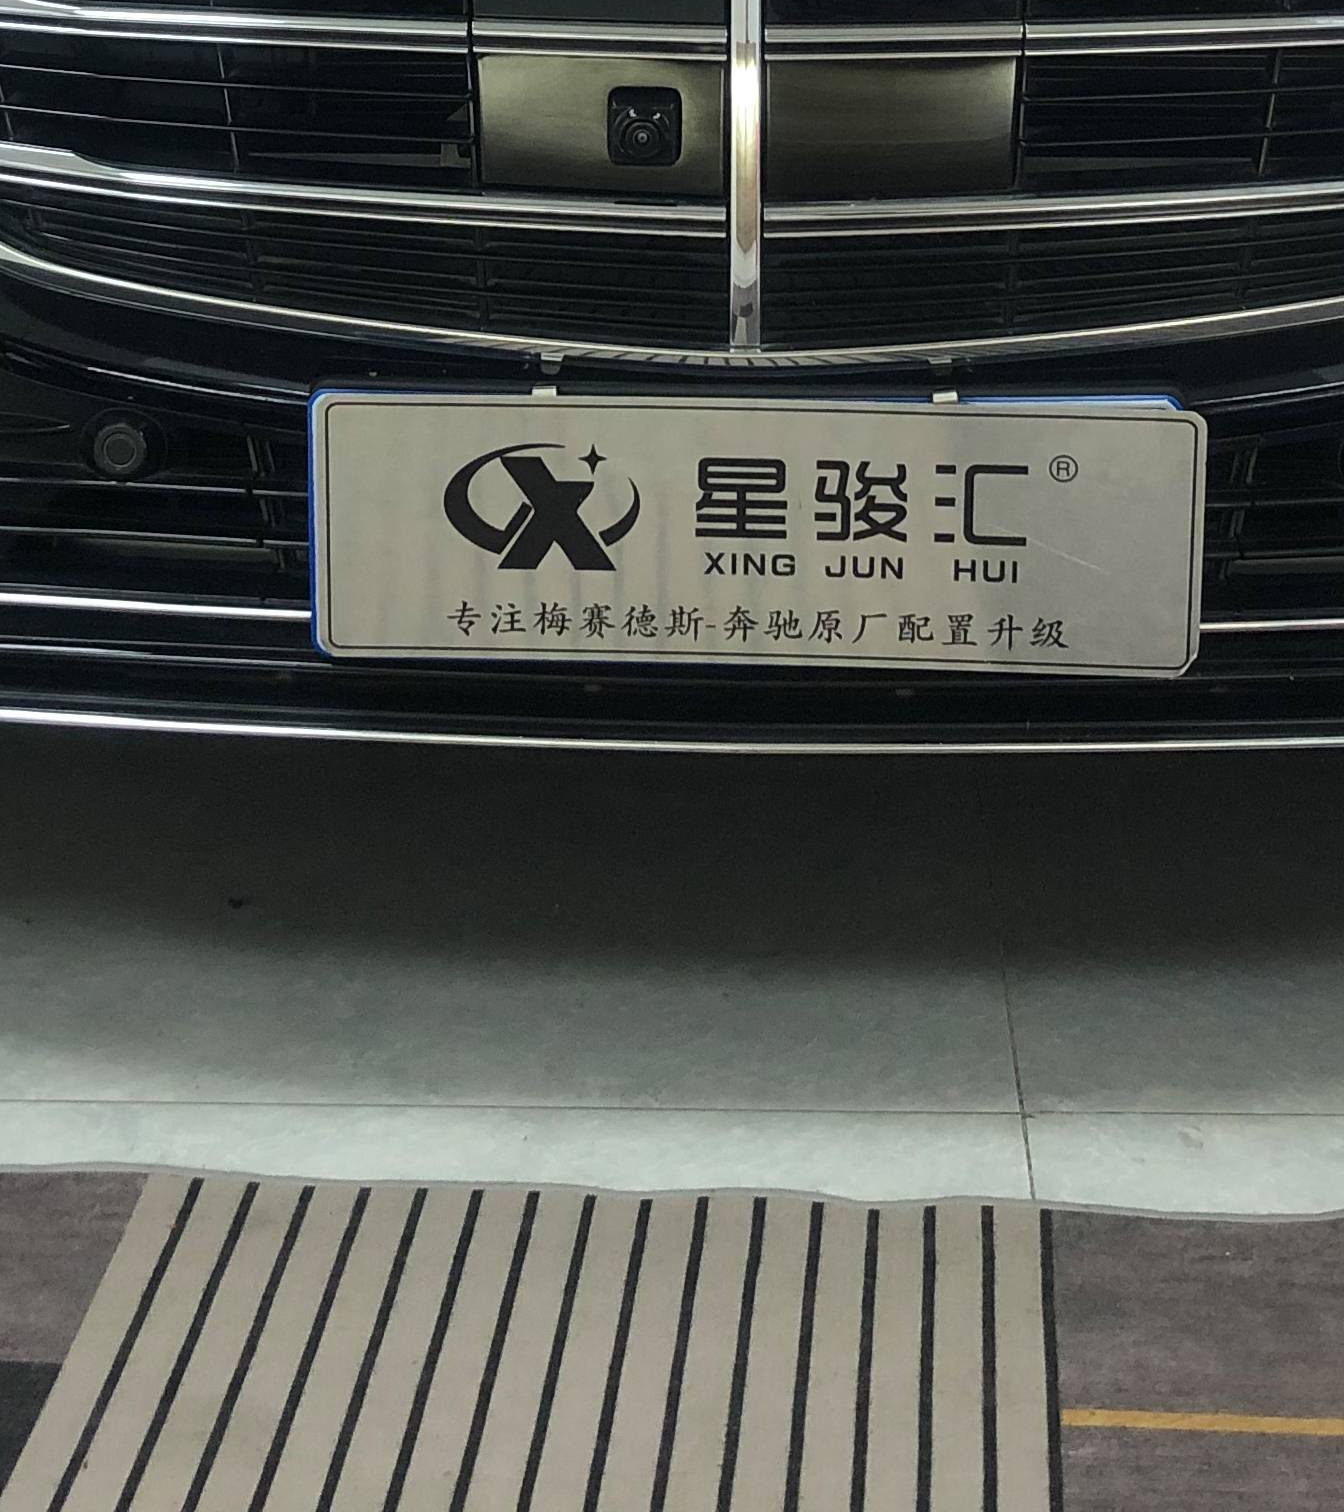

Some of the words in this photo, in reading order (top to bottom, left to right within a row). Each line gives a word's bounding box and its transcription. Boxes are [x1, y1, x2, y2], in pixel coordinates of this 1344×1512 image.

[693, 456, 1030, 548] 星骏汇
[703, 551, 796, 578] XING
[824, 553, 905, 580] JUN
[952, 557, 1021, 584] HUI
[447, 601, 1071, 652] 专注梅赛德斯-奔驰原厂配置升级
